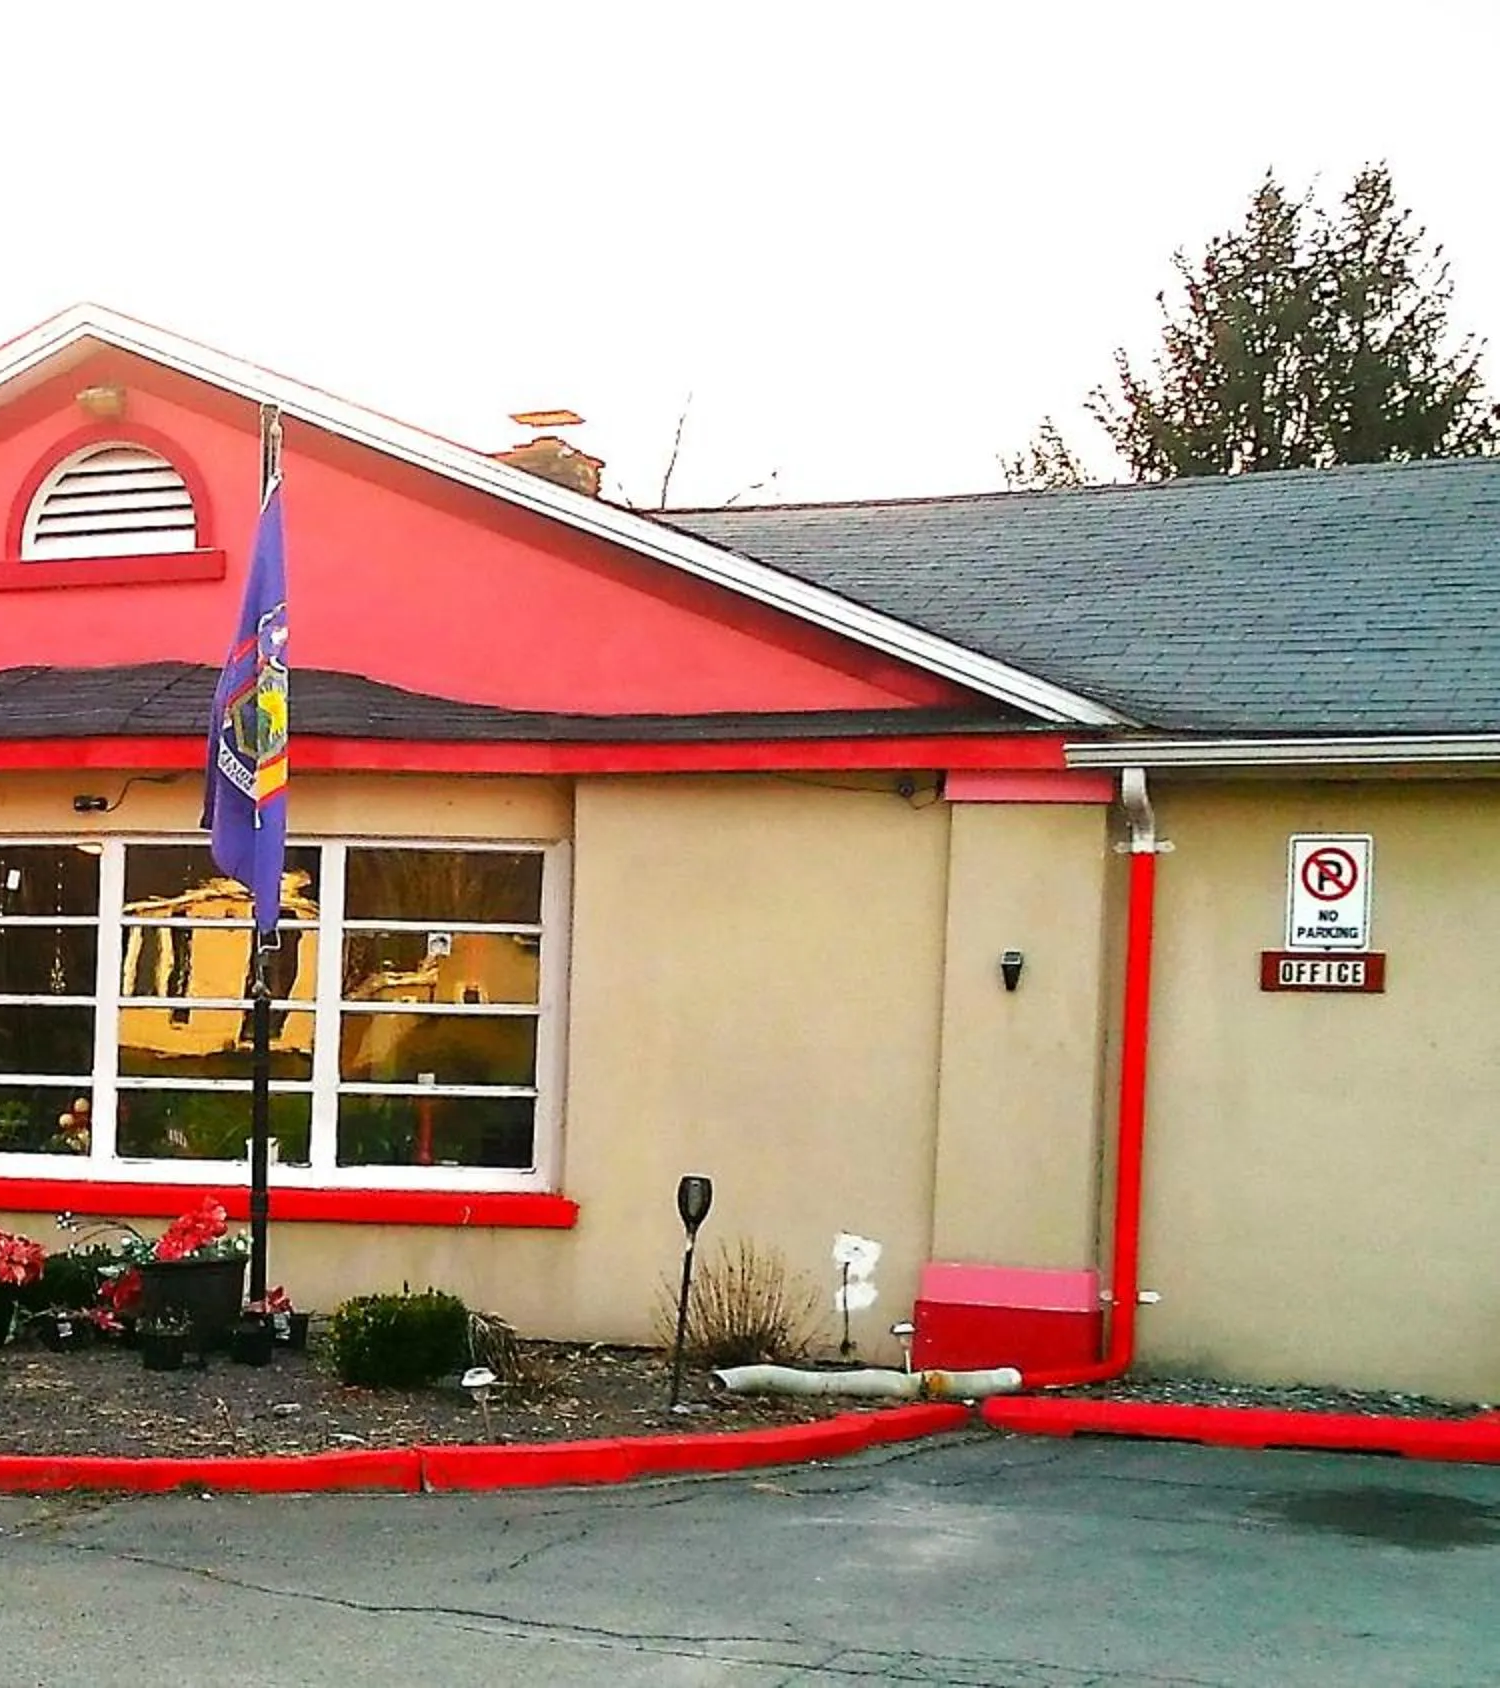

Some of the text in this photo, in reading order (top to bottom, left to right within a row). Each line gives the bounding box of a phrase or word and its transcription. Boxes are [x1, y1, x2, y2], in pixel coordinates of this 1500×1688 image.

[1318, 909, 1339, 923] NO
[1297, 926, 1359, 939] PARKING
[1281, 961, 1363, 983] OFFICE
